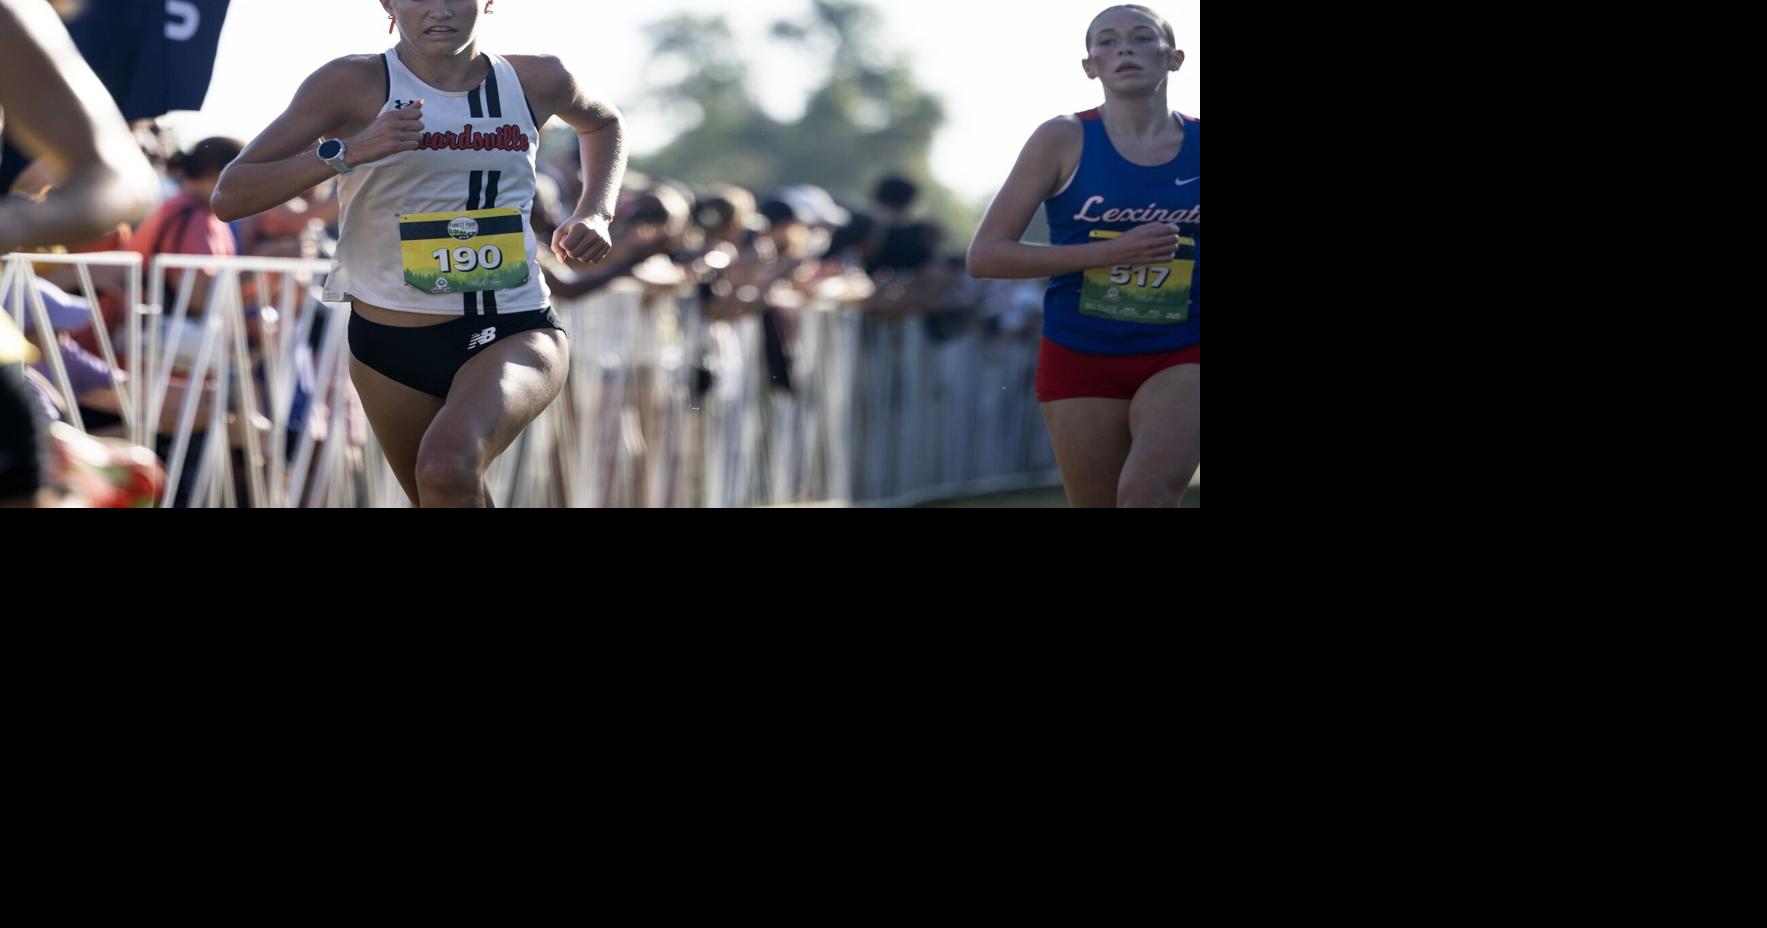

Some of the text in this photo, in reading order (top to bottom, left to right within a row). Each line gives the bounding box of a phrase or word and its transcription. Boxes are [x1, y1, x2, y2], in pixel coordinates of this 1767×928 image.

[1073, 196, 1200, 224] Lexingt
[432, 245, 502, 273] 190
[1110, 264, 1171, 288] 517
